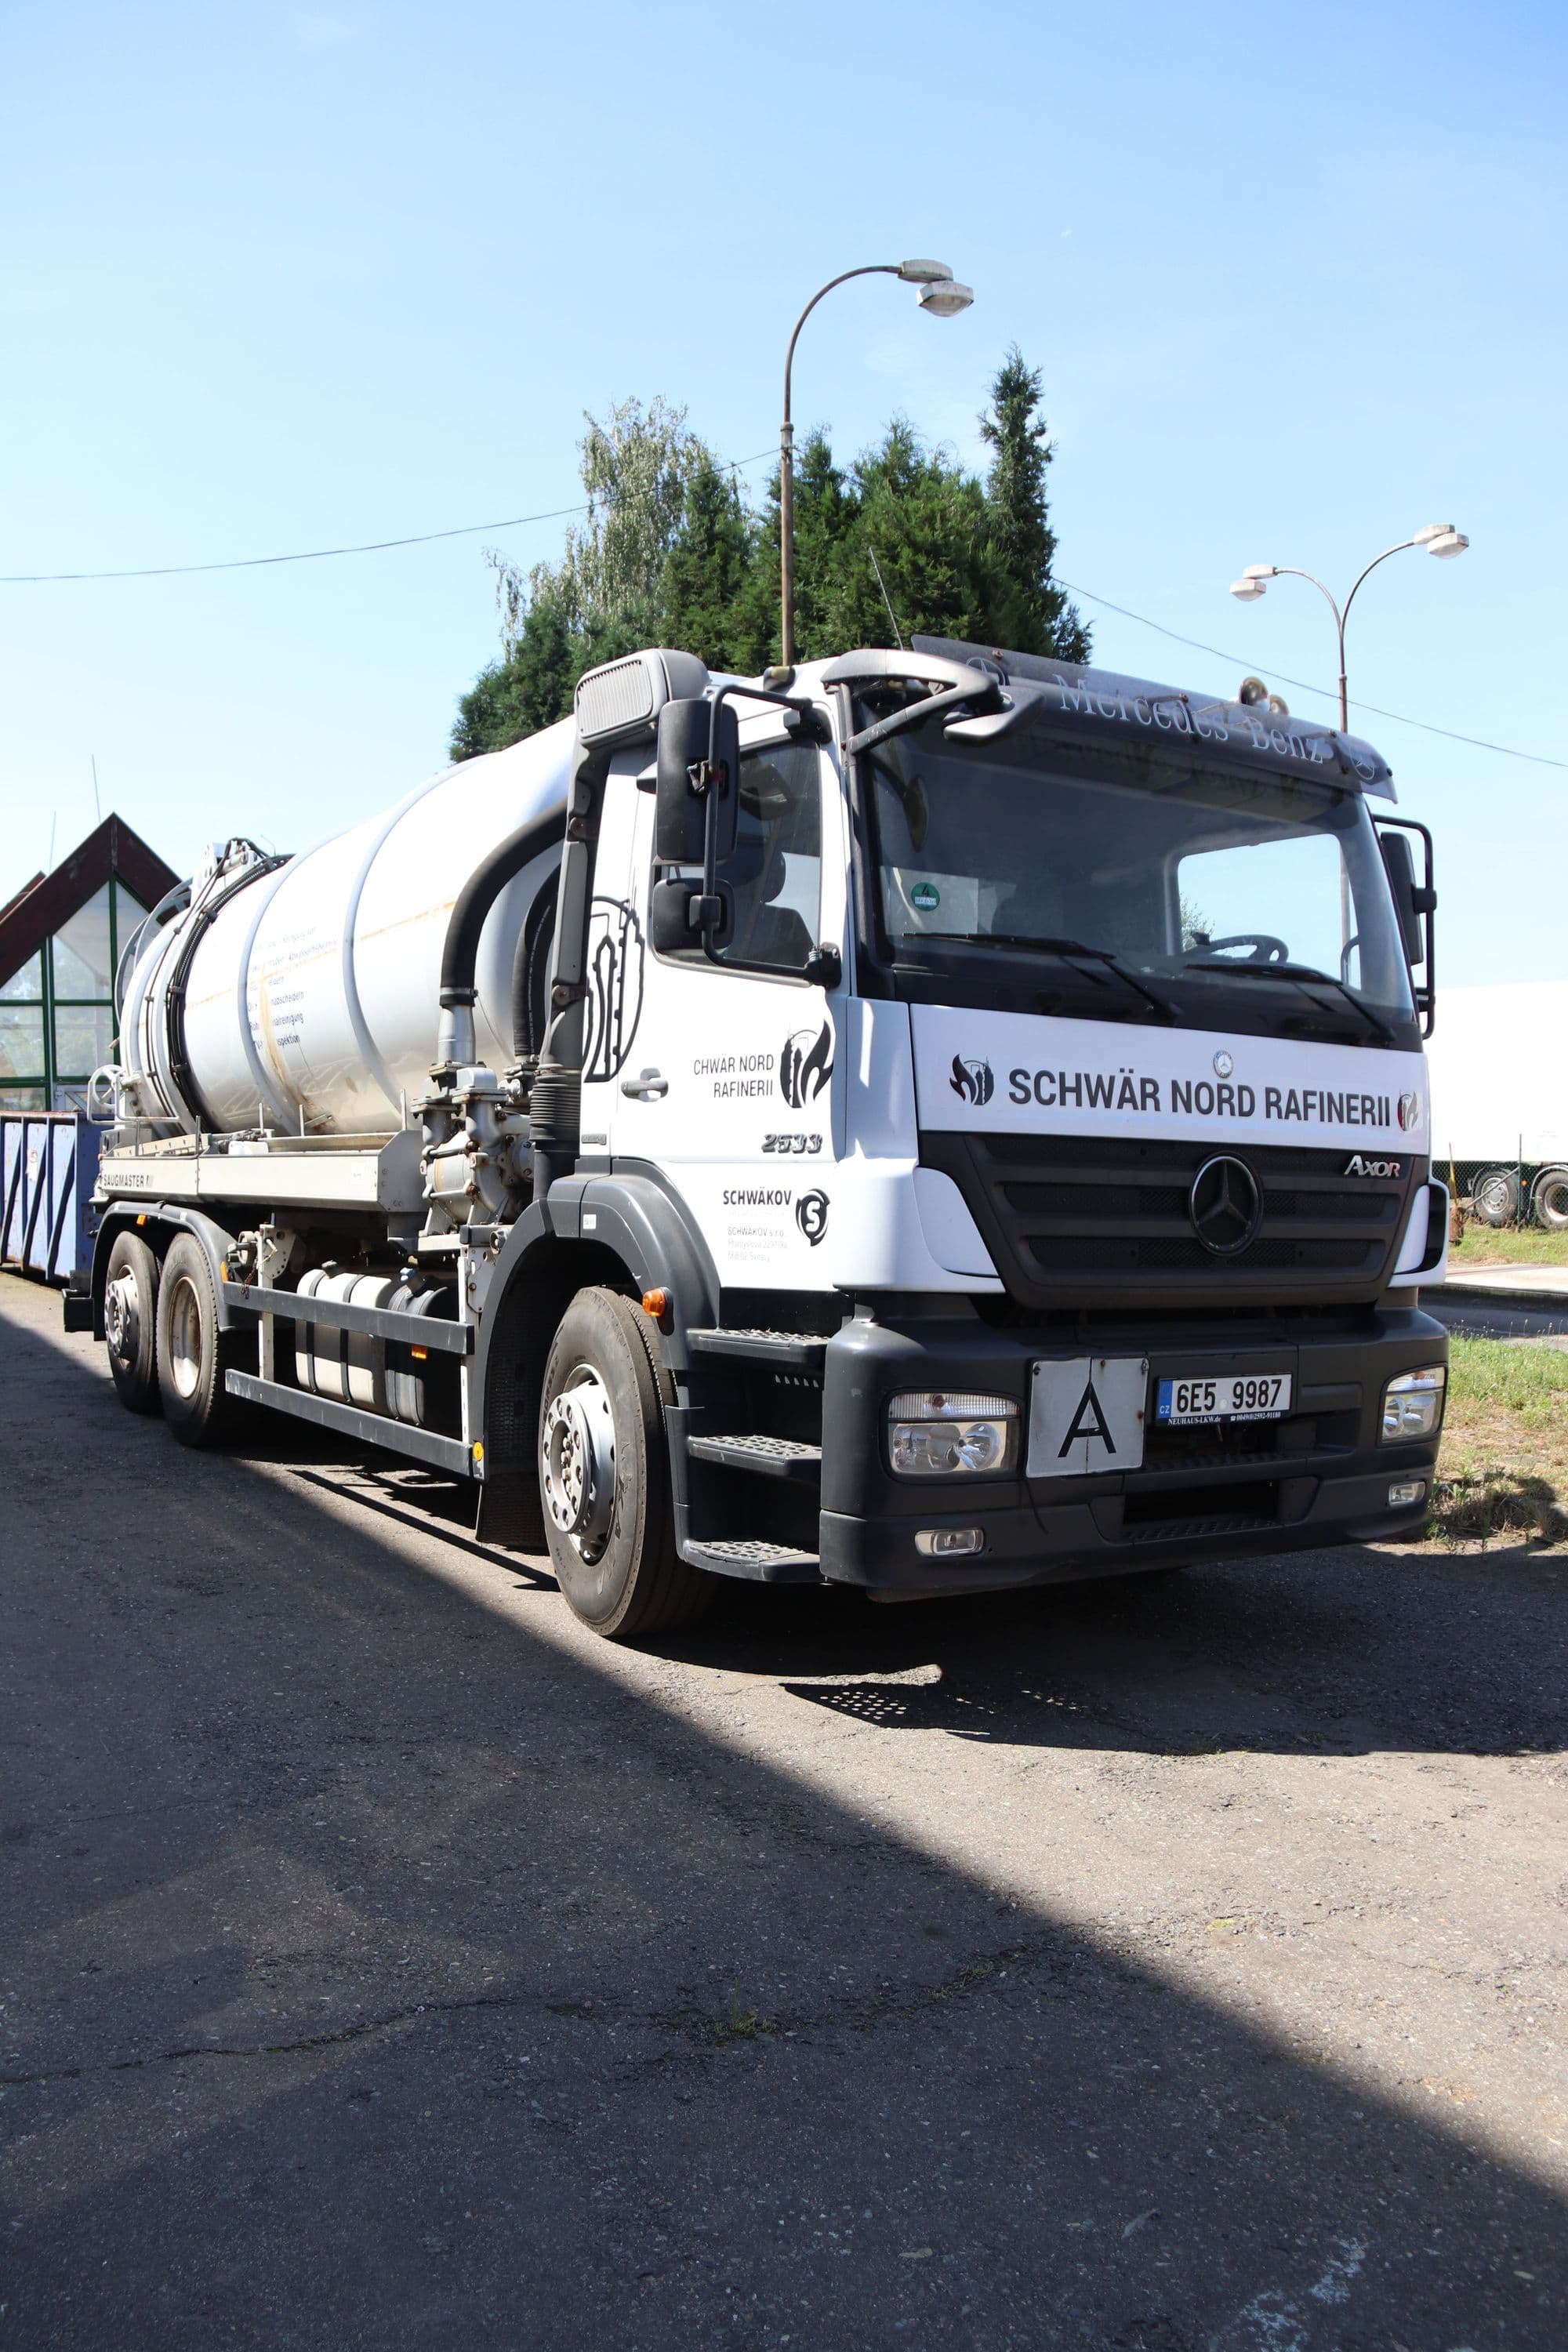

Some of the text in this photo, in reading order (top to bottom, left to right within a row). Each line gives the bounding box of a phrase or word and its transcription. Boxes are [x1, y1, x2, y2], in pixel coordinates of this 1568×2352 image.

[1052, 673, 1323, 764] Mercedes Benz
[921, 884, 930, 897] 4
[694, 1054, 775, 1076] CHWÄR NORD
[713, 1079, 774, 1098] RAFINERII
[1008, 1067, 1391, 1127] SCHWÄR NORD RAFINERII
[761, 1133, 823, 1155] 2533
[103, 1173, 144, 1188] SAUGMASTER
[723, 1185, 792, 1206] SCHWÄKOV
[1160, 1378, 1283, 1414] CZ 6E5 9987
[1057, 1381, 1117, 1458] A
[1167, 1415, 1221, 1426] NEUHAUS-LKW.de
